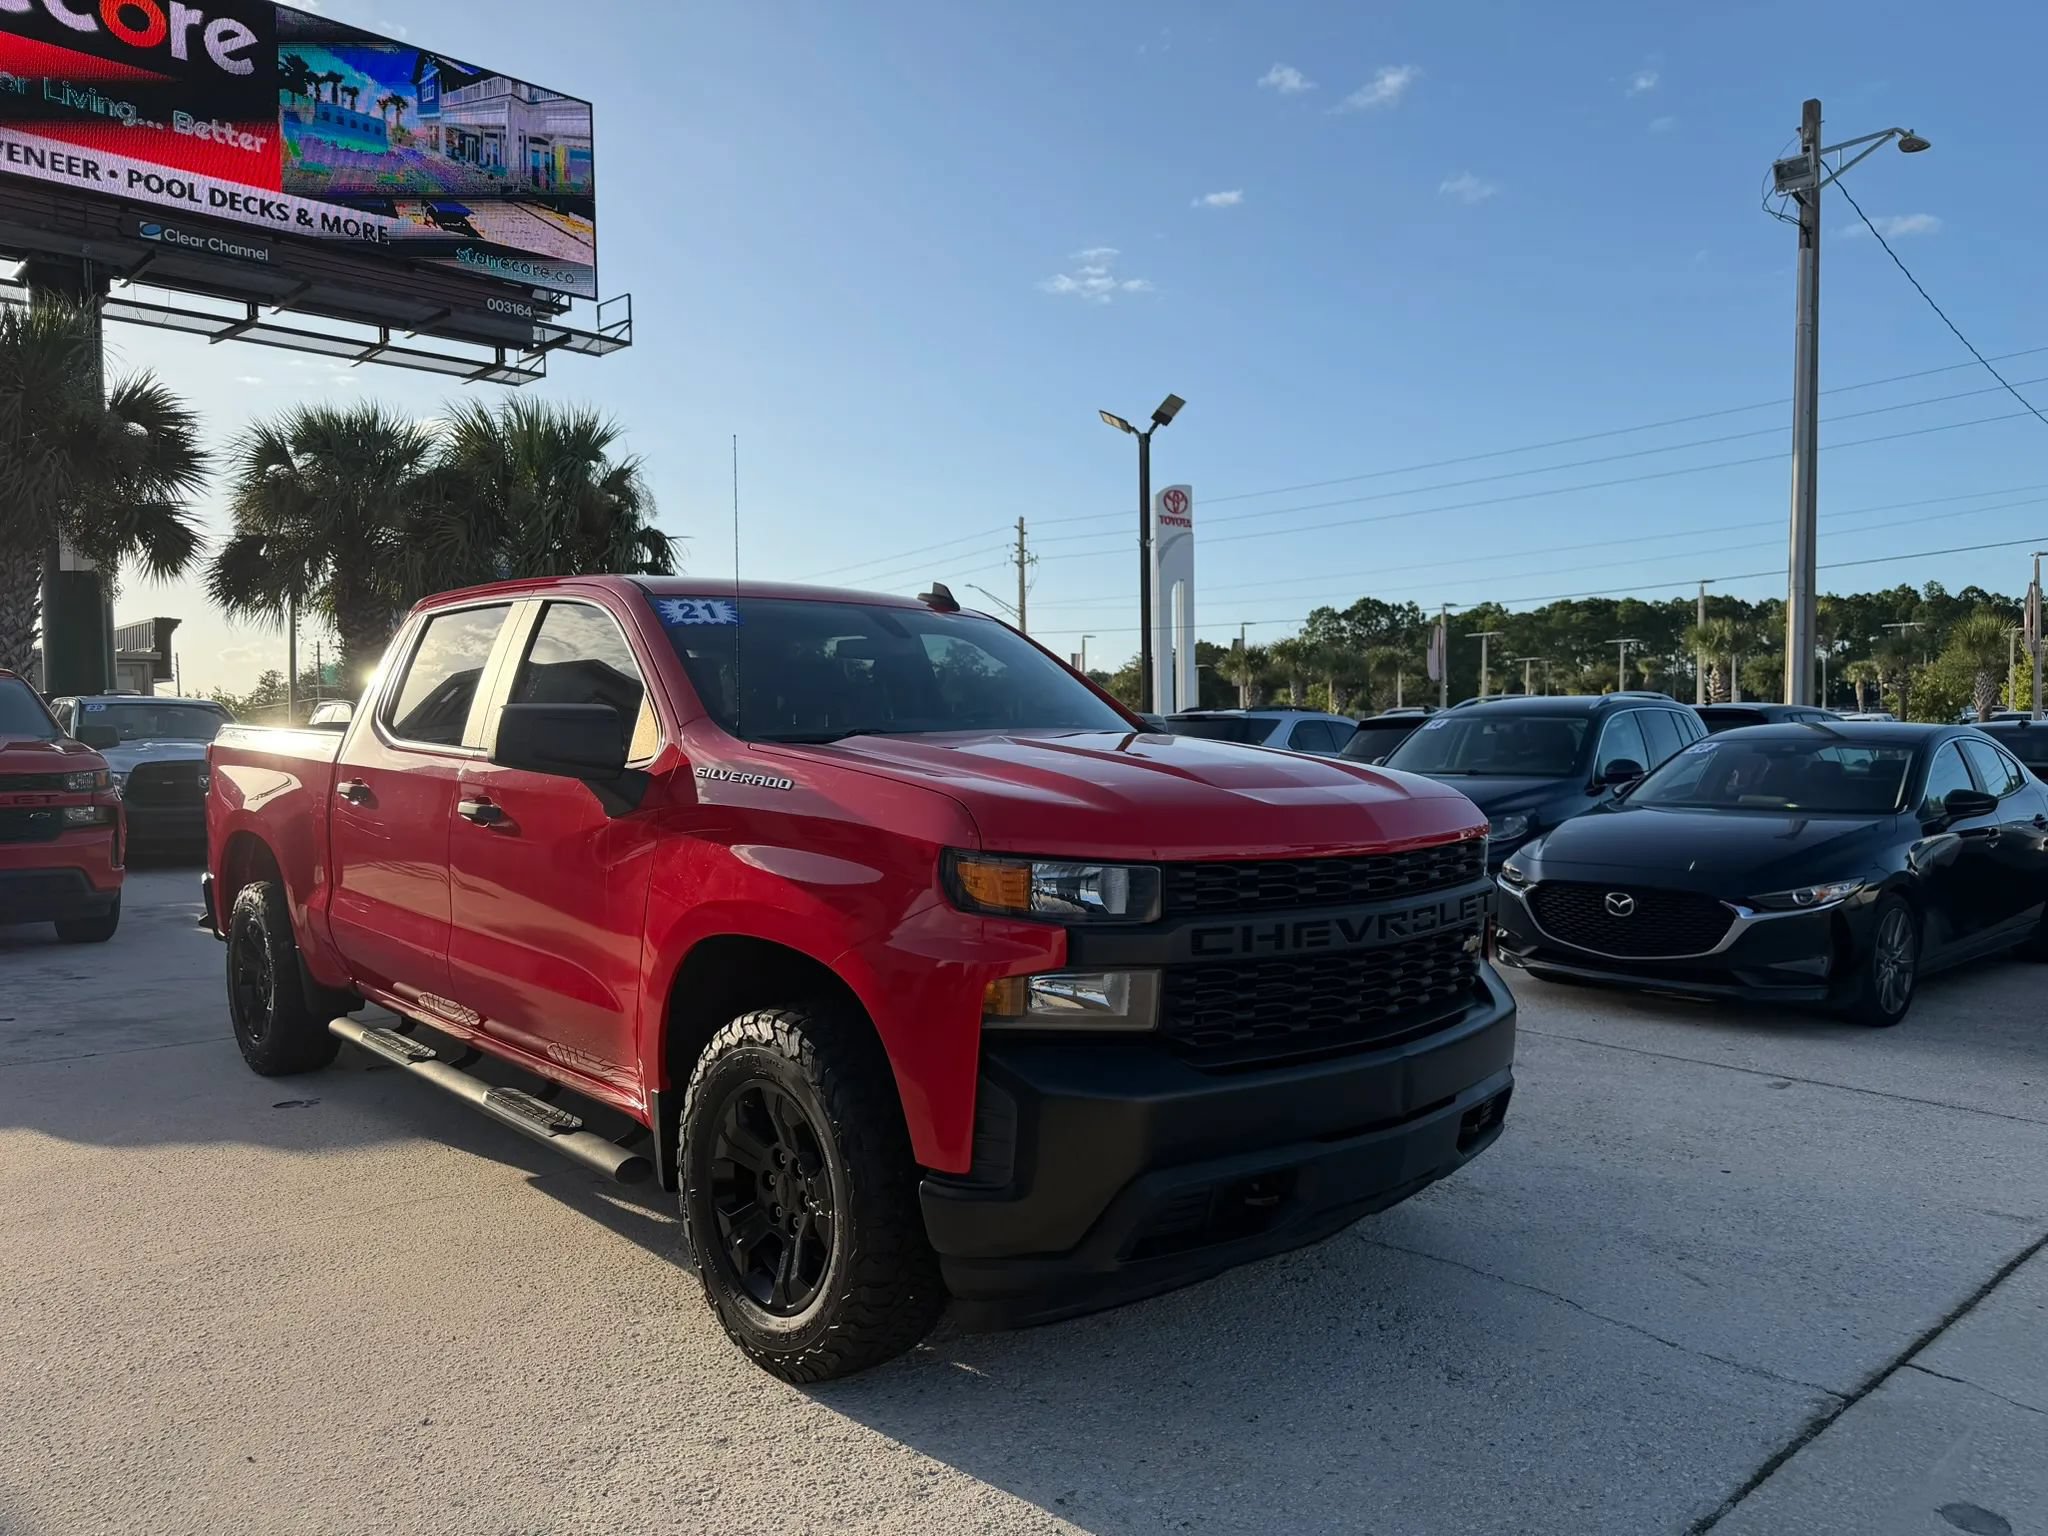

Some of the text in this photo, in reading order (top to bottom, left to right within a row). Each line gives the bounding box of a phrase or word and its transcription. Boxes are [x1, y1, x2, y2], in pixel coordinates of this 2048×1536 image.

[173, 110, 267, 153] Better
[0, 140, 390, 245] ENEER POOL DECKS & MORE
[164, 228, 269, 261] Clear Channel
[487, 298, 532, 317] 003164
[1159, 514, 1192, 528] TOYOTA
[678, 602, 718, 620] 21
[695, 767, 795, 792] SILVERADO
[1191, 889, 1493, 957] CHEVROLET
